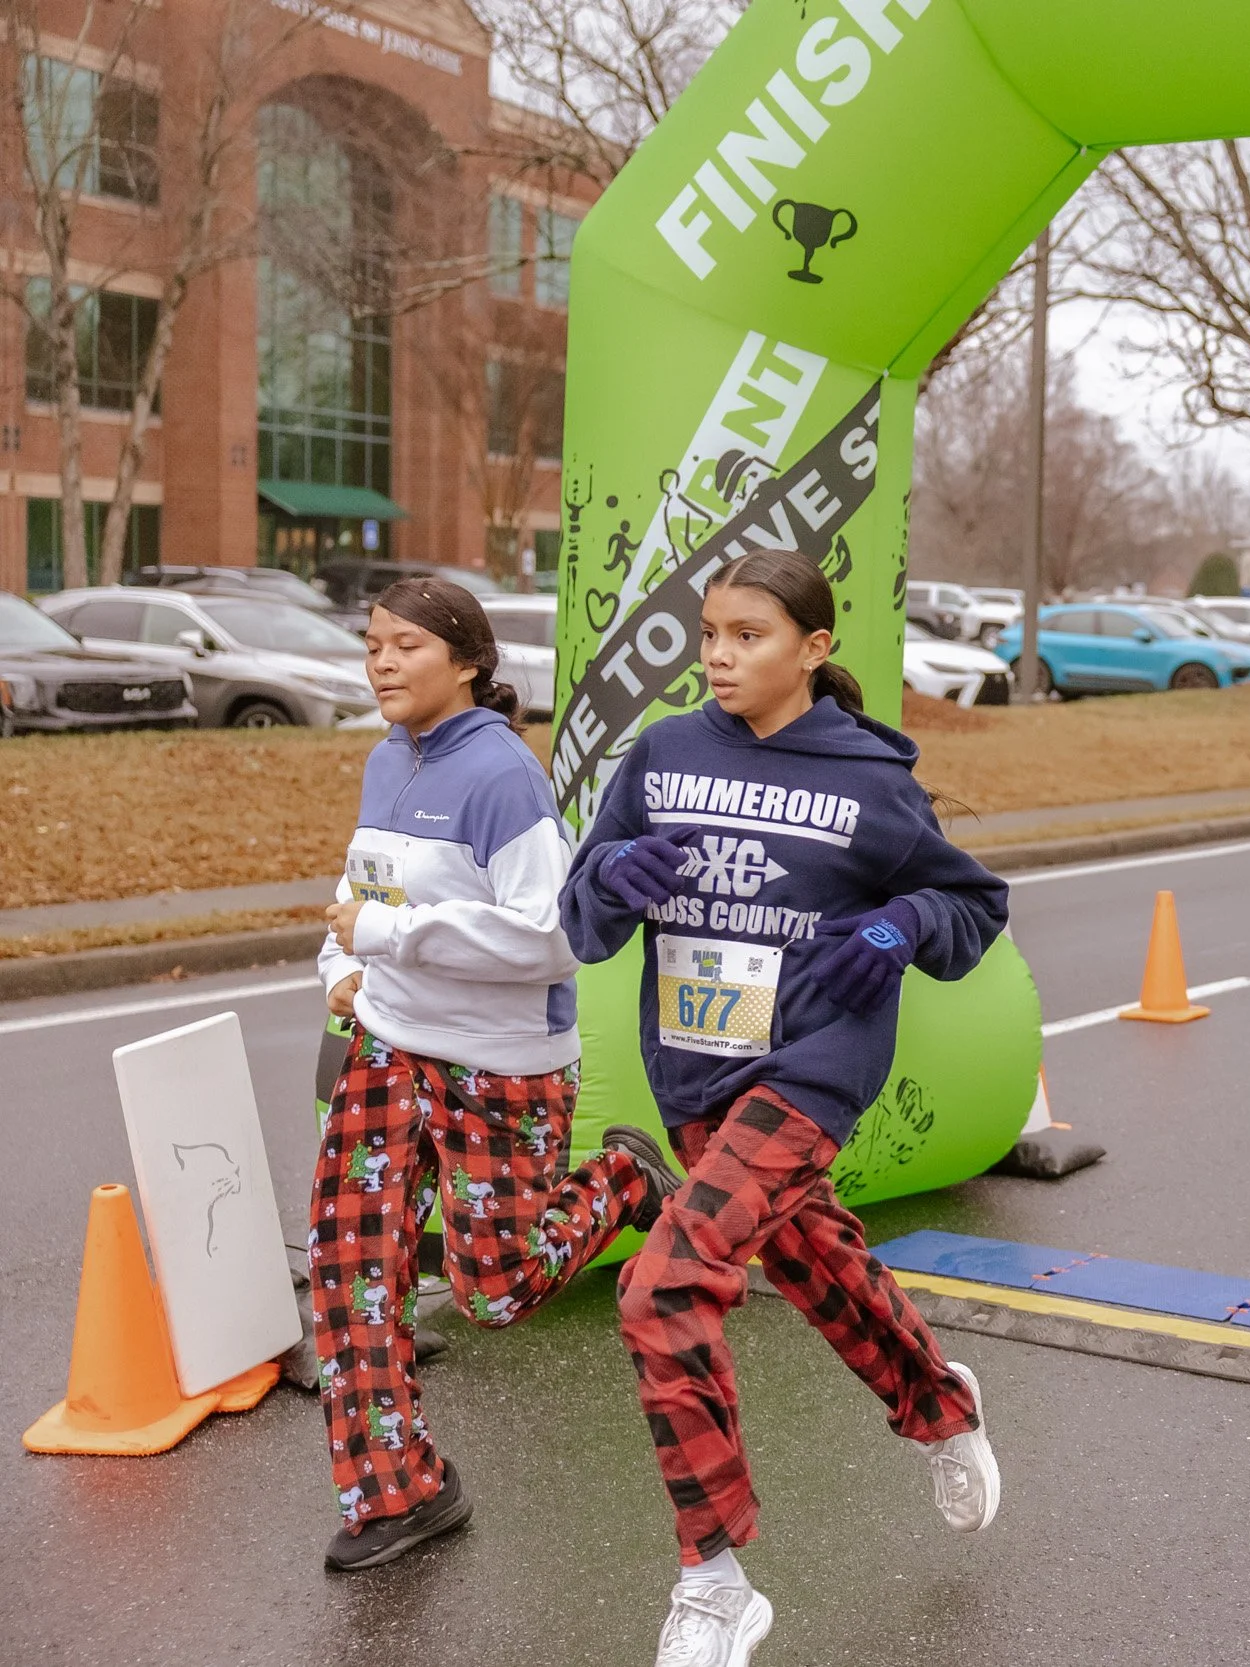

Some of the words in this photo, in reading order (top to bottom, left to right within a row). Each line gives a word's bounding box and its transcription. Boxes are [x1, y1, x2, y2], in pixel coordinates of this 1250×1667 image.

[655, 0, 932, 282] FINISH
[550, 692, 610, 813] ME
[599, 611, 688, 699] TO
[644, 771, 861, 836] SUMMEROUR
[697, 834, 766, 898] XC
[646, 895, 705, 928] ROSS
[709, 900, 823, 940] COUNTRY
[678, 983, 742, 1031] 677
[670, 1033, 753, 1051] www.FiveStarNTP.com
